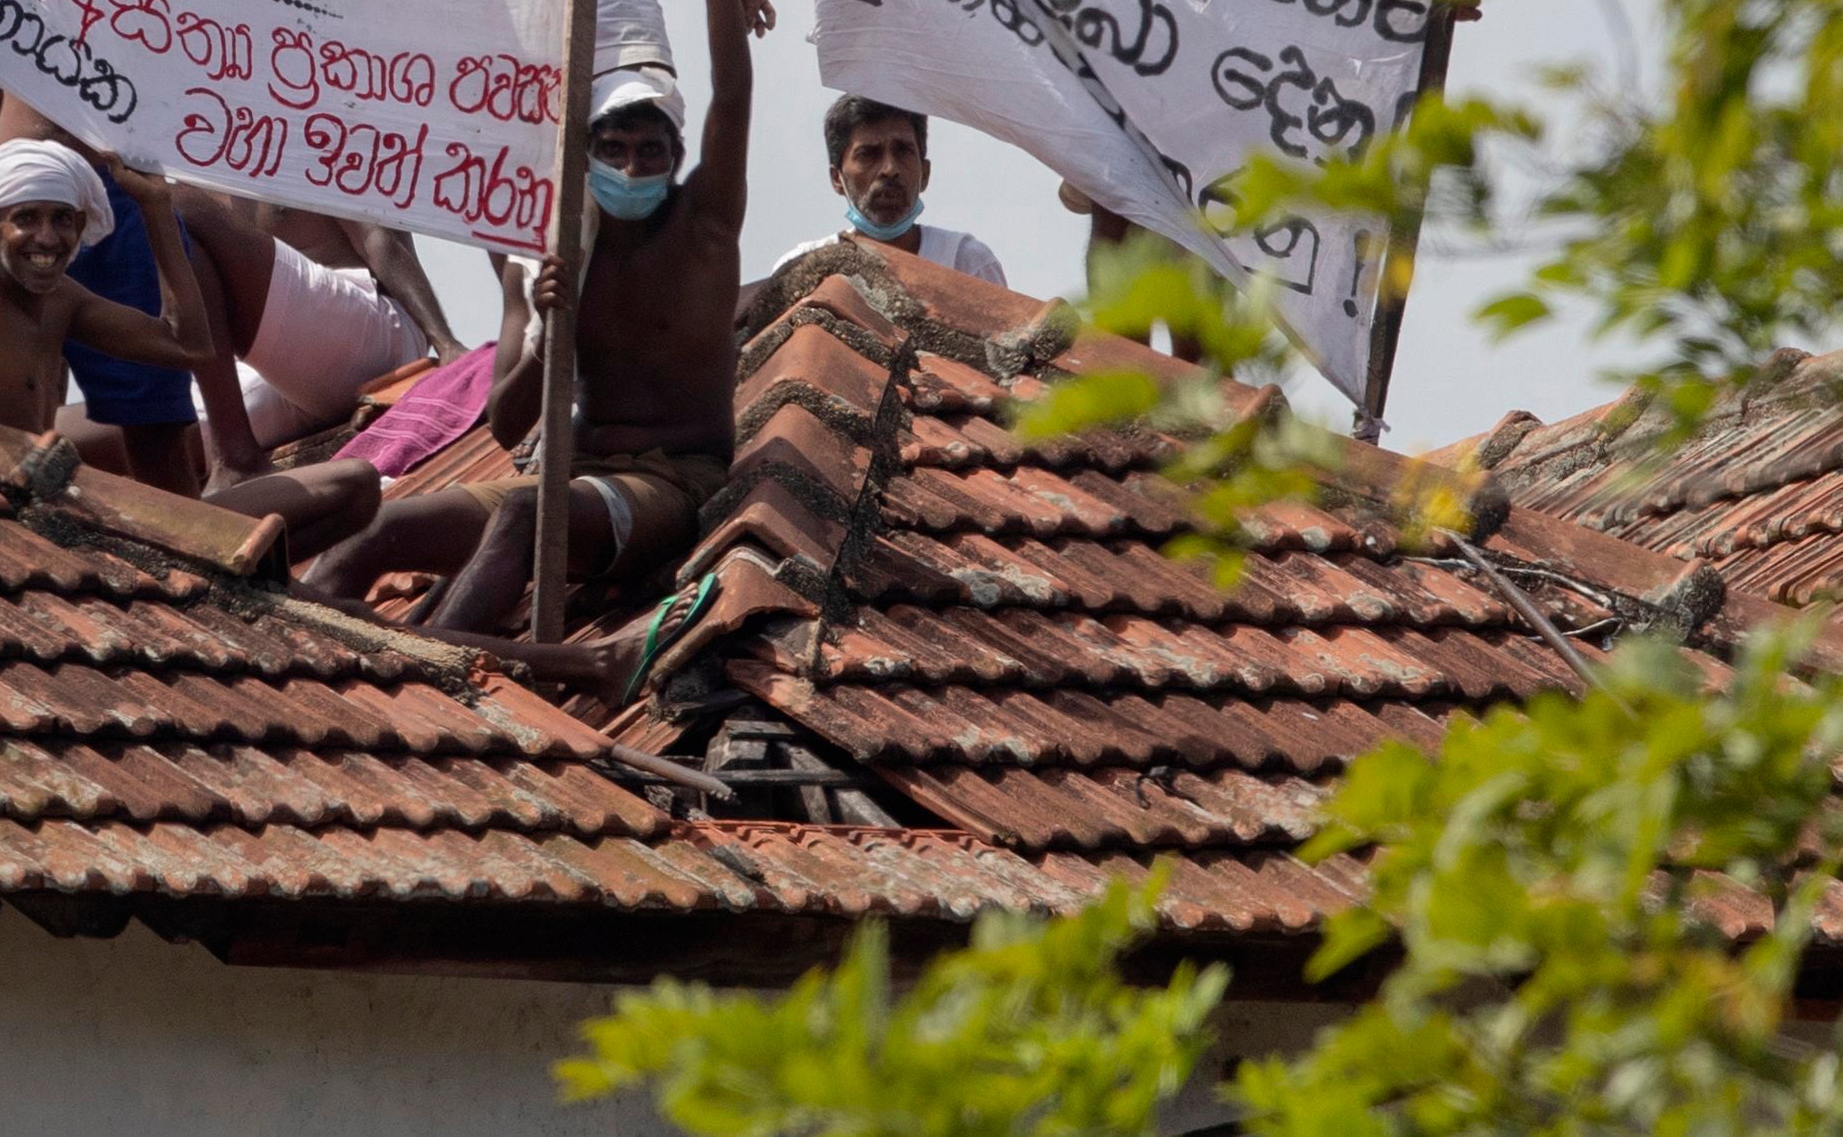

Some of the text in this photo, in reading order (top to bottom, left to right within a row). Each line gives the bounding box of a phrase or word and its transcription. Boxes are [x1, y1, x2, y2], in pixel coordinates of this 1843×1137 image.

[175, 87, 554, 252] වහා ඉවත් කරනු
